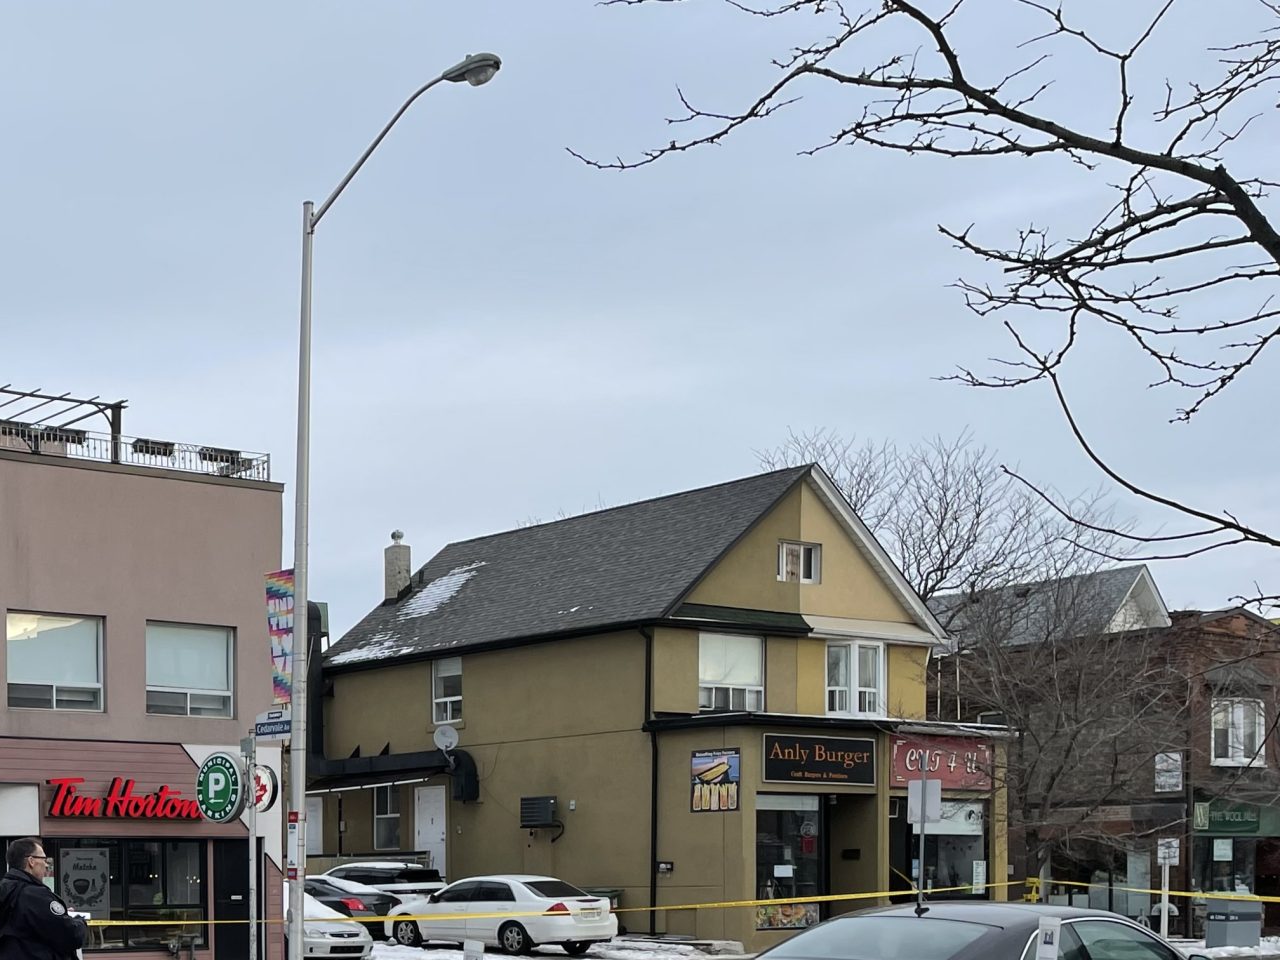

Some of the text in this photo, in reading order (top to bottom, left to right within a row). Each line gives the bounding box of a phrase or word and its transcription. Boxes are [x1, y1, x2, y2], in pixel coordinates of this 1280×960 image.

[770, 742, 870, 769] Anly Burger
[947, 751, 958, 773] 4
[199, 758, 237, 782] MUNICIPAL
[46, 777, 100, 817] Tim
[208, 772, 226, 798] P
[198, 793, 237, 819] PARKING
